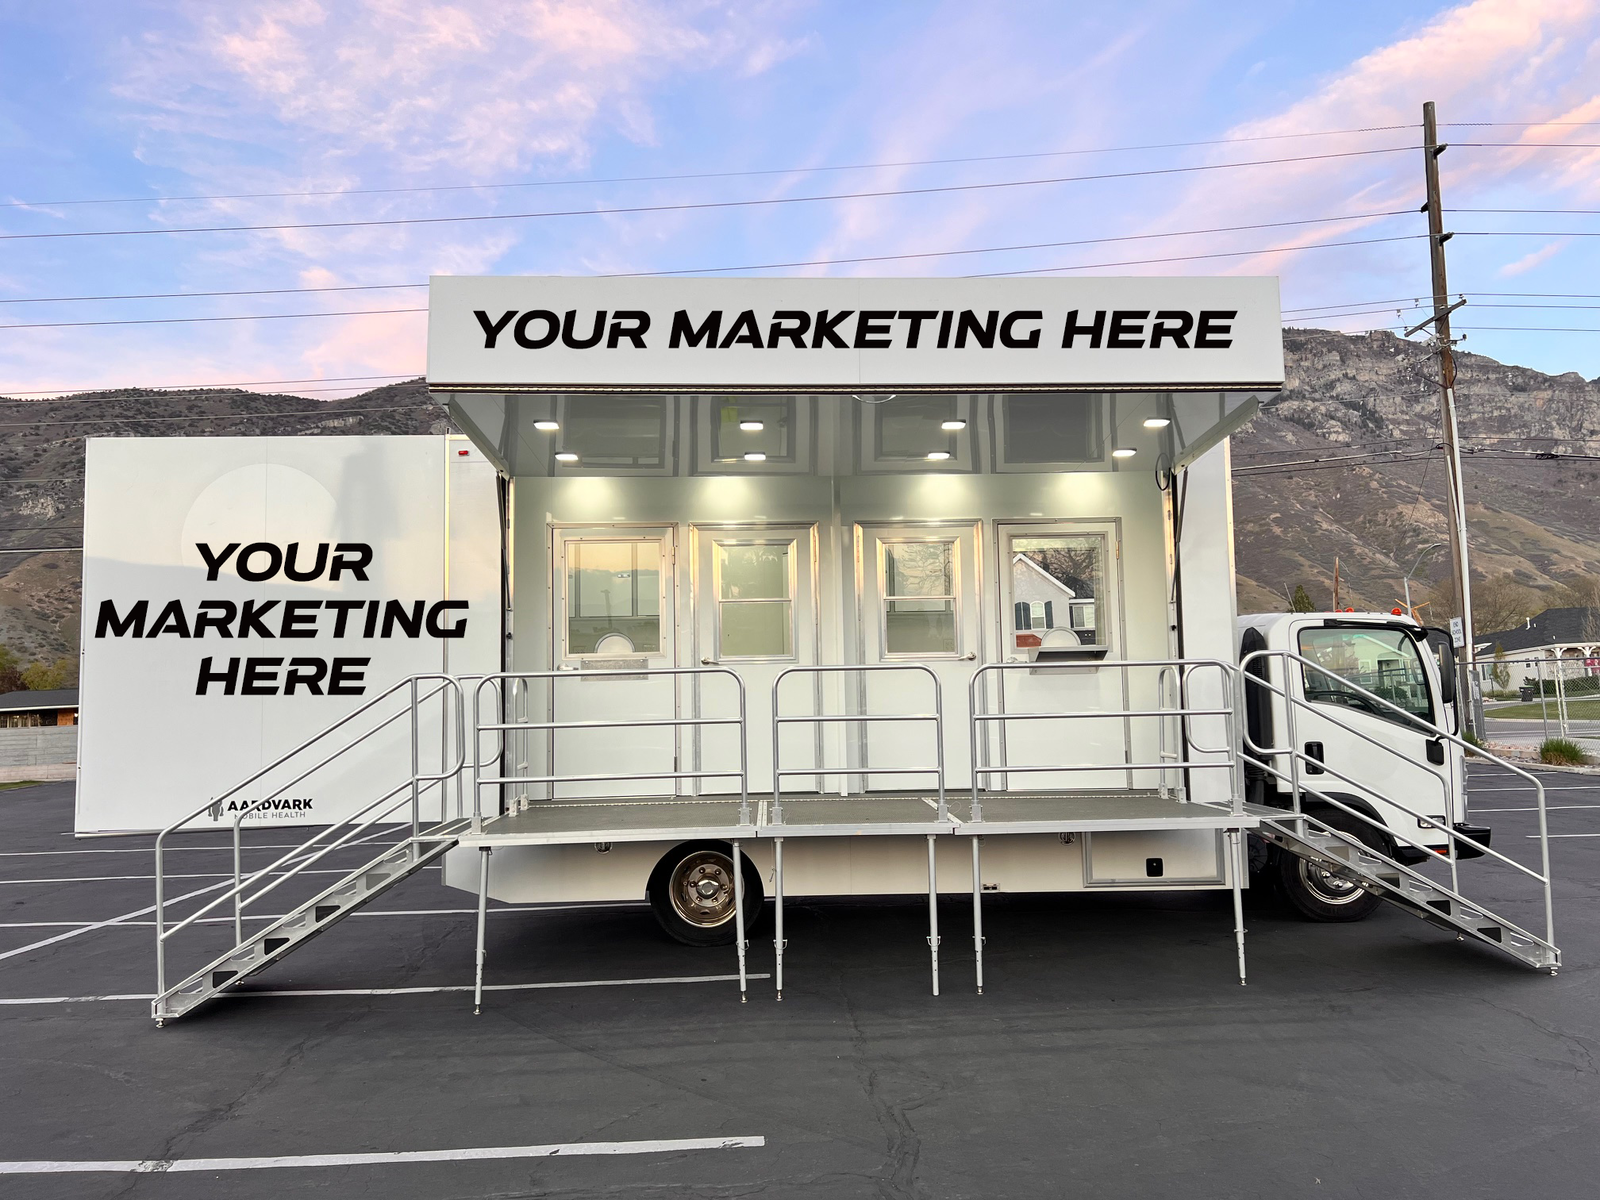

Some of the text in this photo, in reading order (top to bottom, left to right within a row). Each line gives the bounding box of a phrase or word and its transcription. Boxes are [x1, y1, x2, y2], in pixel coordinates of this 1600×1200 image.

[473, 309, 1238, 350] YOUR MARKETING HERE
[195, 542, 373, 582] YOUR
[95, 599, 469, 639] MARKETING
[195, 656, 372, 696] HERE
[271, 811, 306, 819] HEALTH
